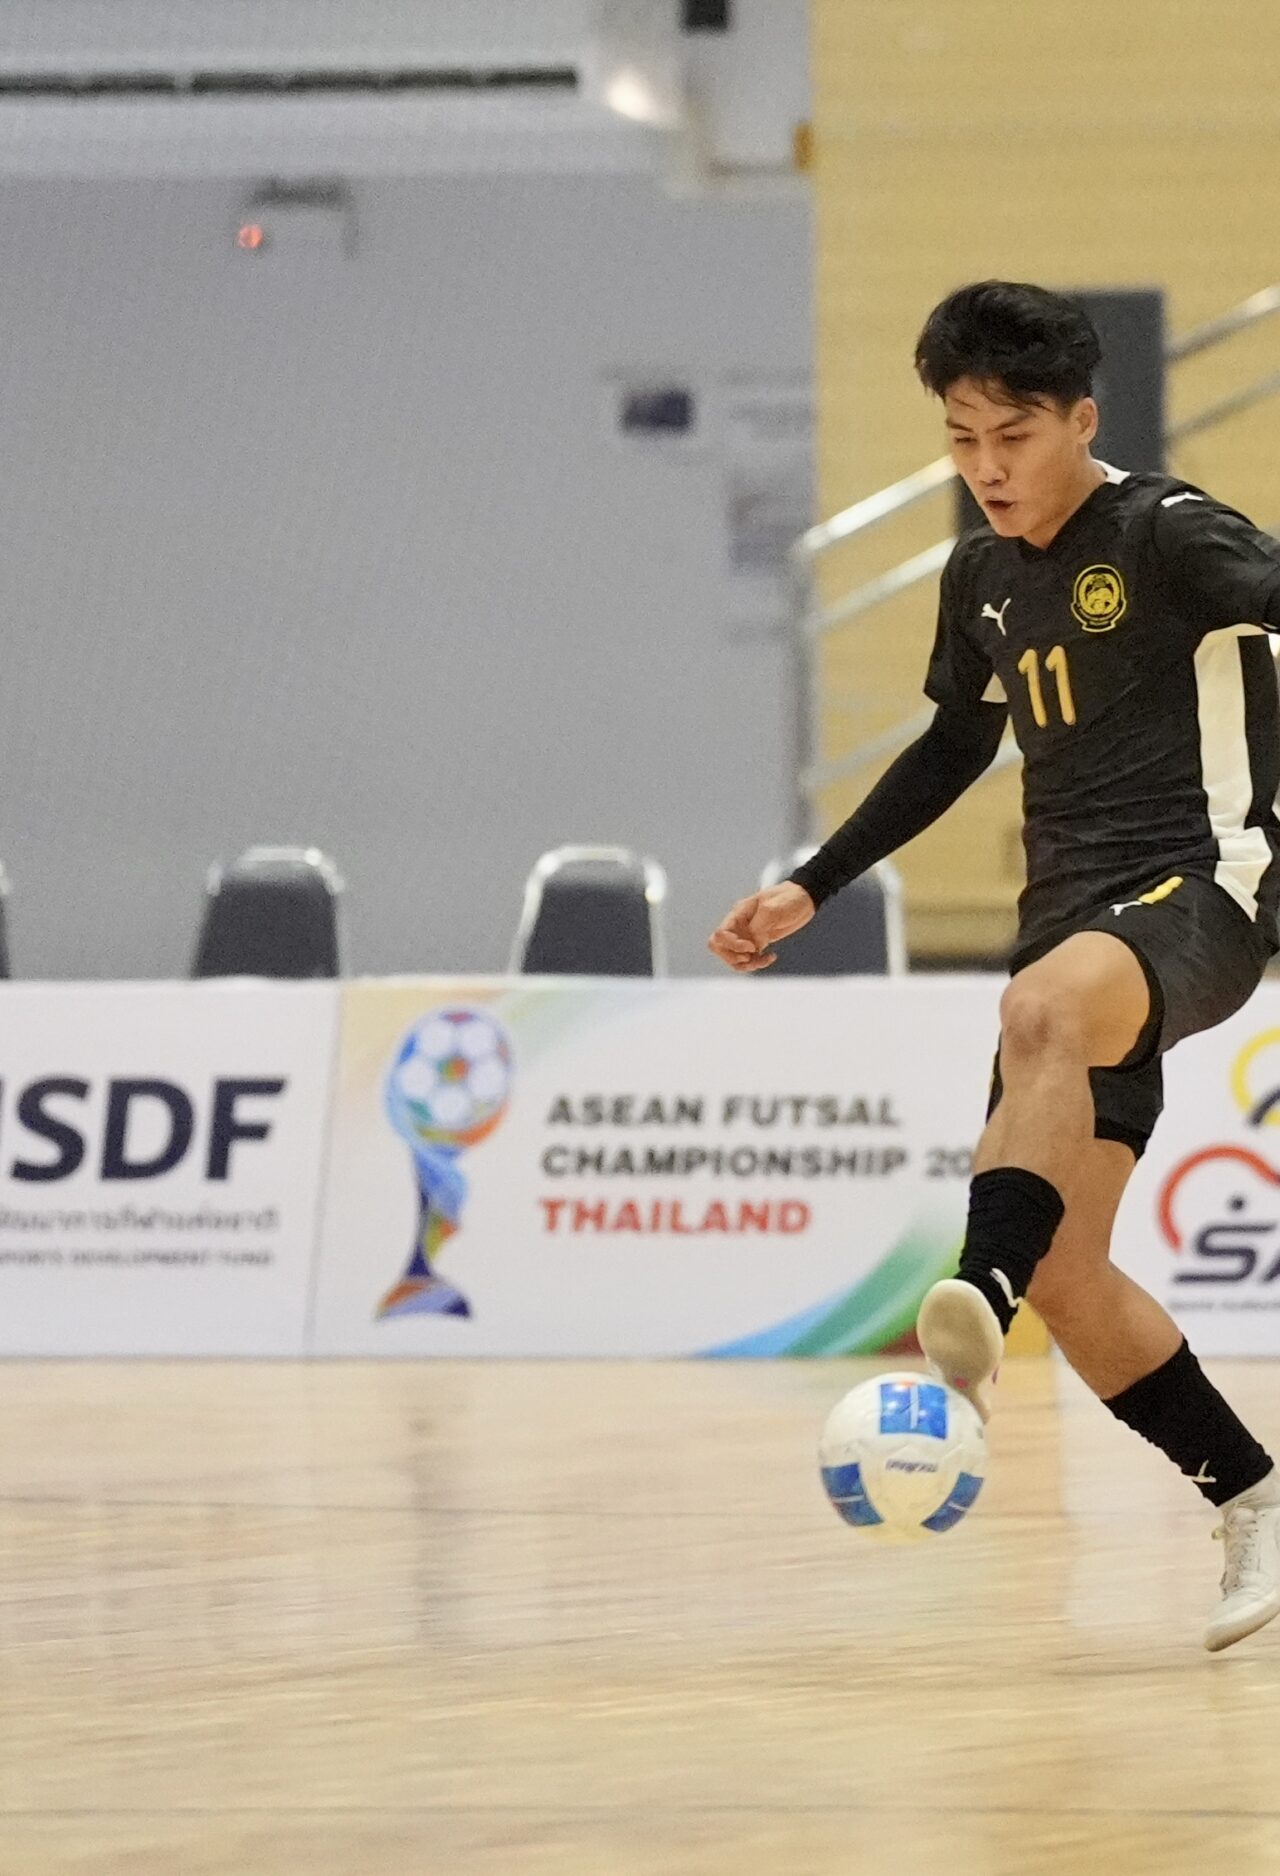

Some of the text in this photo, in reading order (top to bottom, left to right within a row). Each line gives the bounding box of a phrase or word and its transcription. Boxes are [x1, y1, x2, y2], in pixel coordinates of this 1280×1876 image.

[1018, 645, 1077, 728] 11
[0, 1077, 286, 1183] SDF
[546, 1094, 900, 1129] ASEAN FUTSAL
[540, 1144, 975, 1181] CHAMPIONSHIP 20
[536, 1195, 814, 1238] THAILAND
